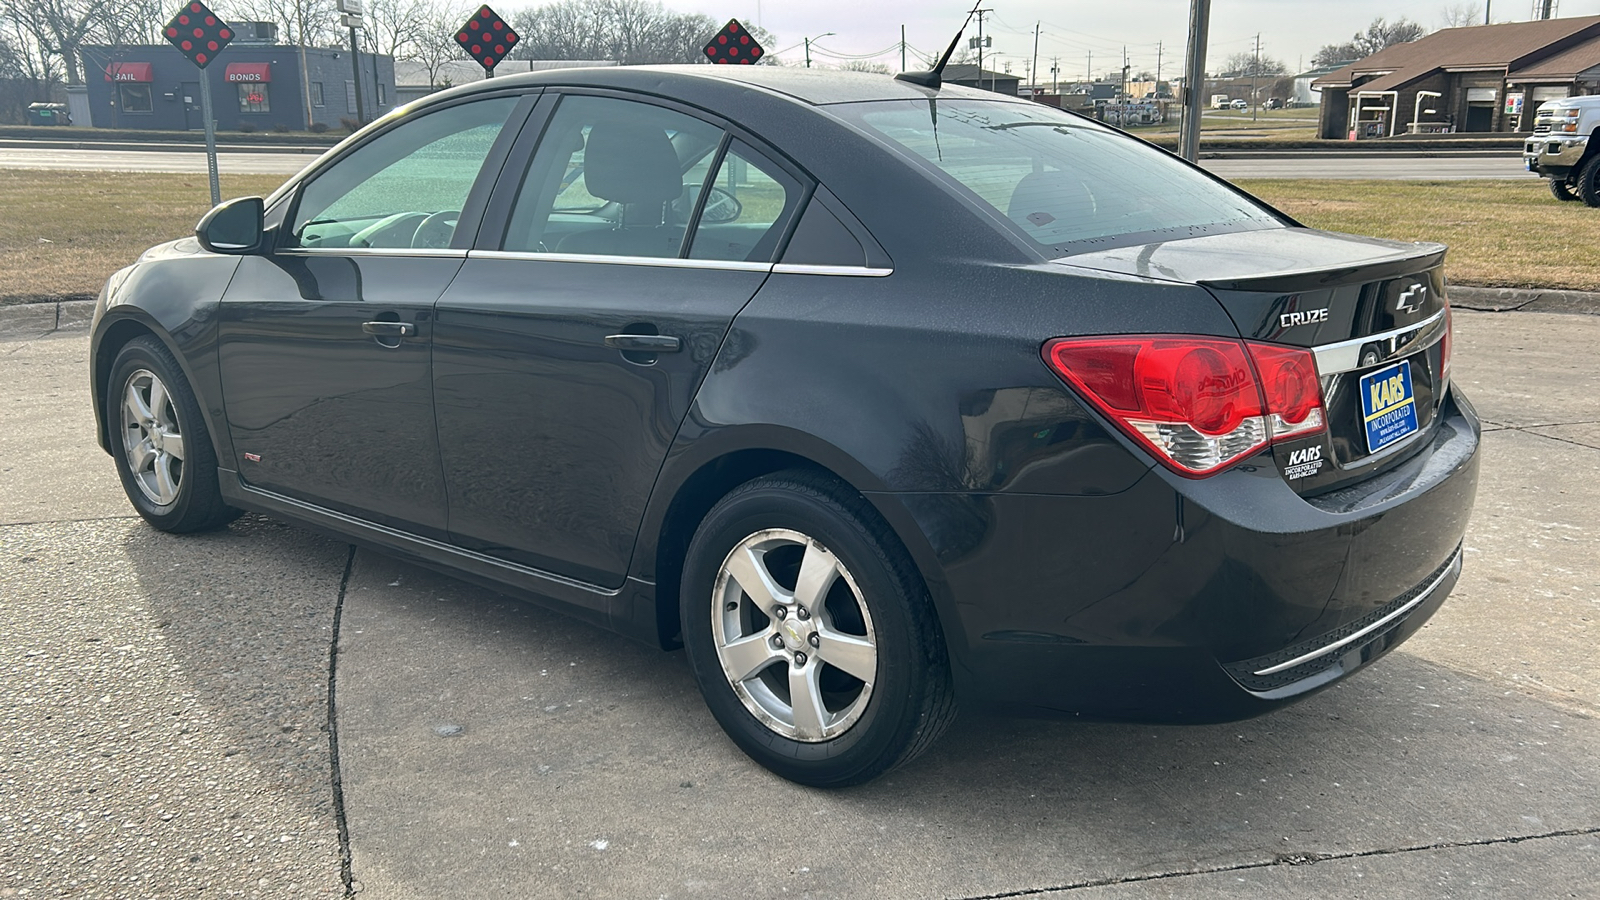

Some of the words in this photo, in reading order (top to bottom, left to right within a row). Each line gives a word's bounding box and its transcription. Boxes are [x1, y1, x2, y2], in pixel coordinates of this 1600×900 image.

[229, 73, 261, 81] BONDS
[1280, 308, 1329, 328] CRUZE
[1371, 374, 1405, 413] KARS
[1371, 405, 1410, 432] INCORPORATED
[1288, 445, 1322, 466] KARS
